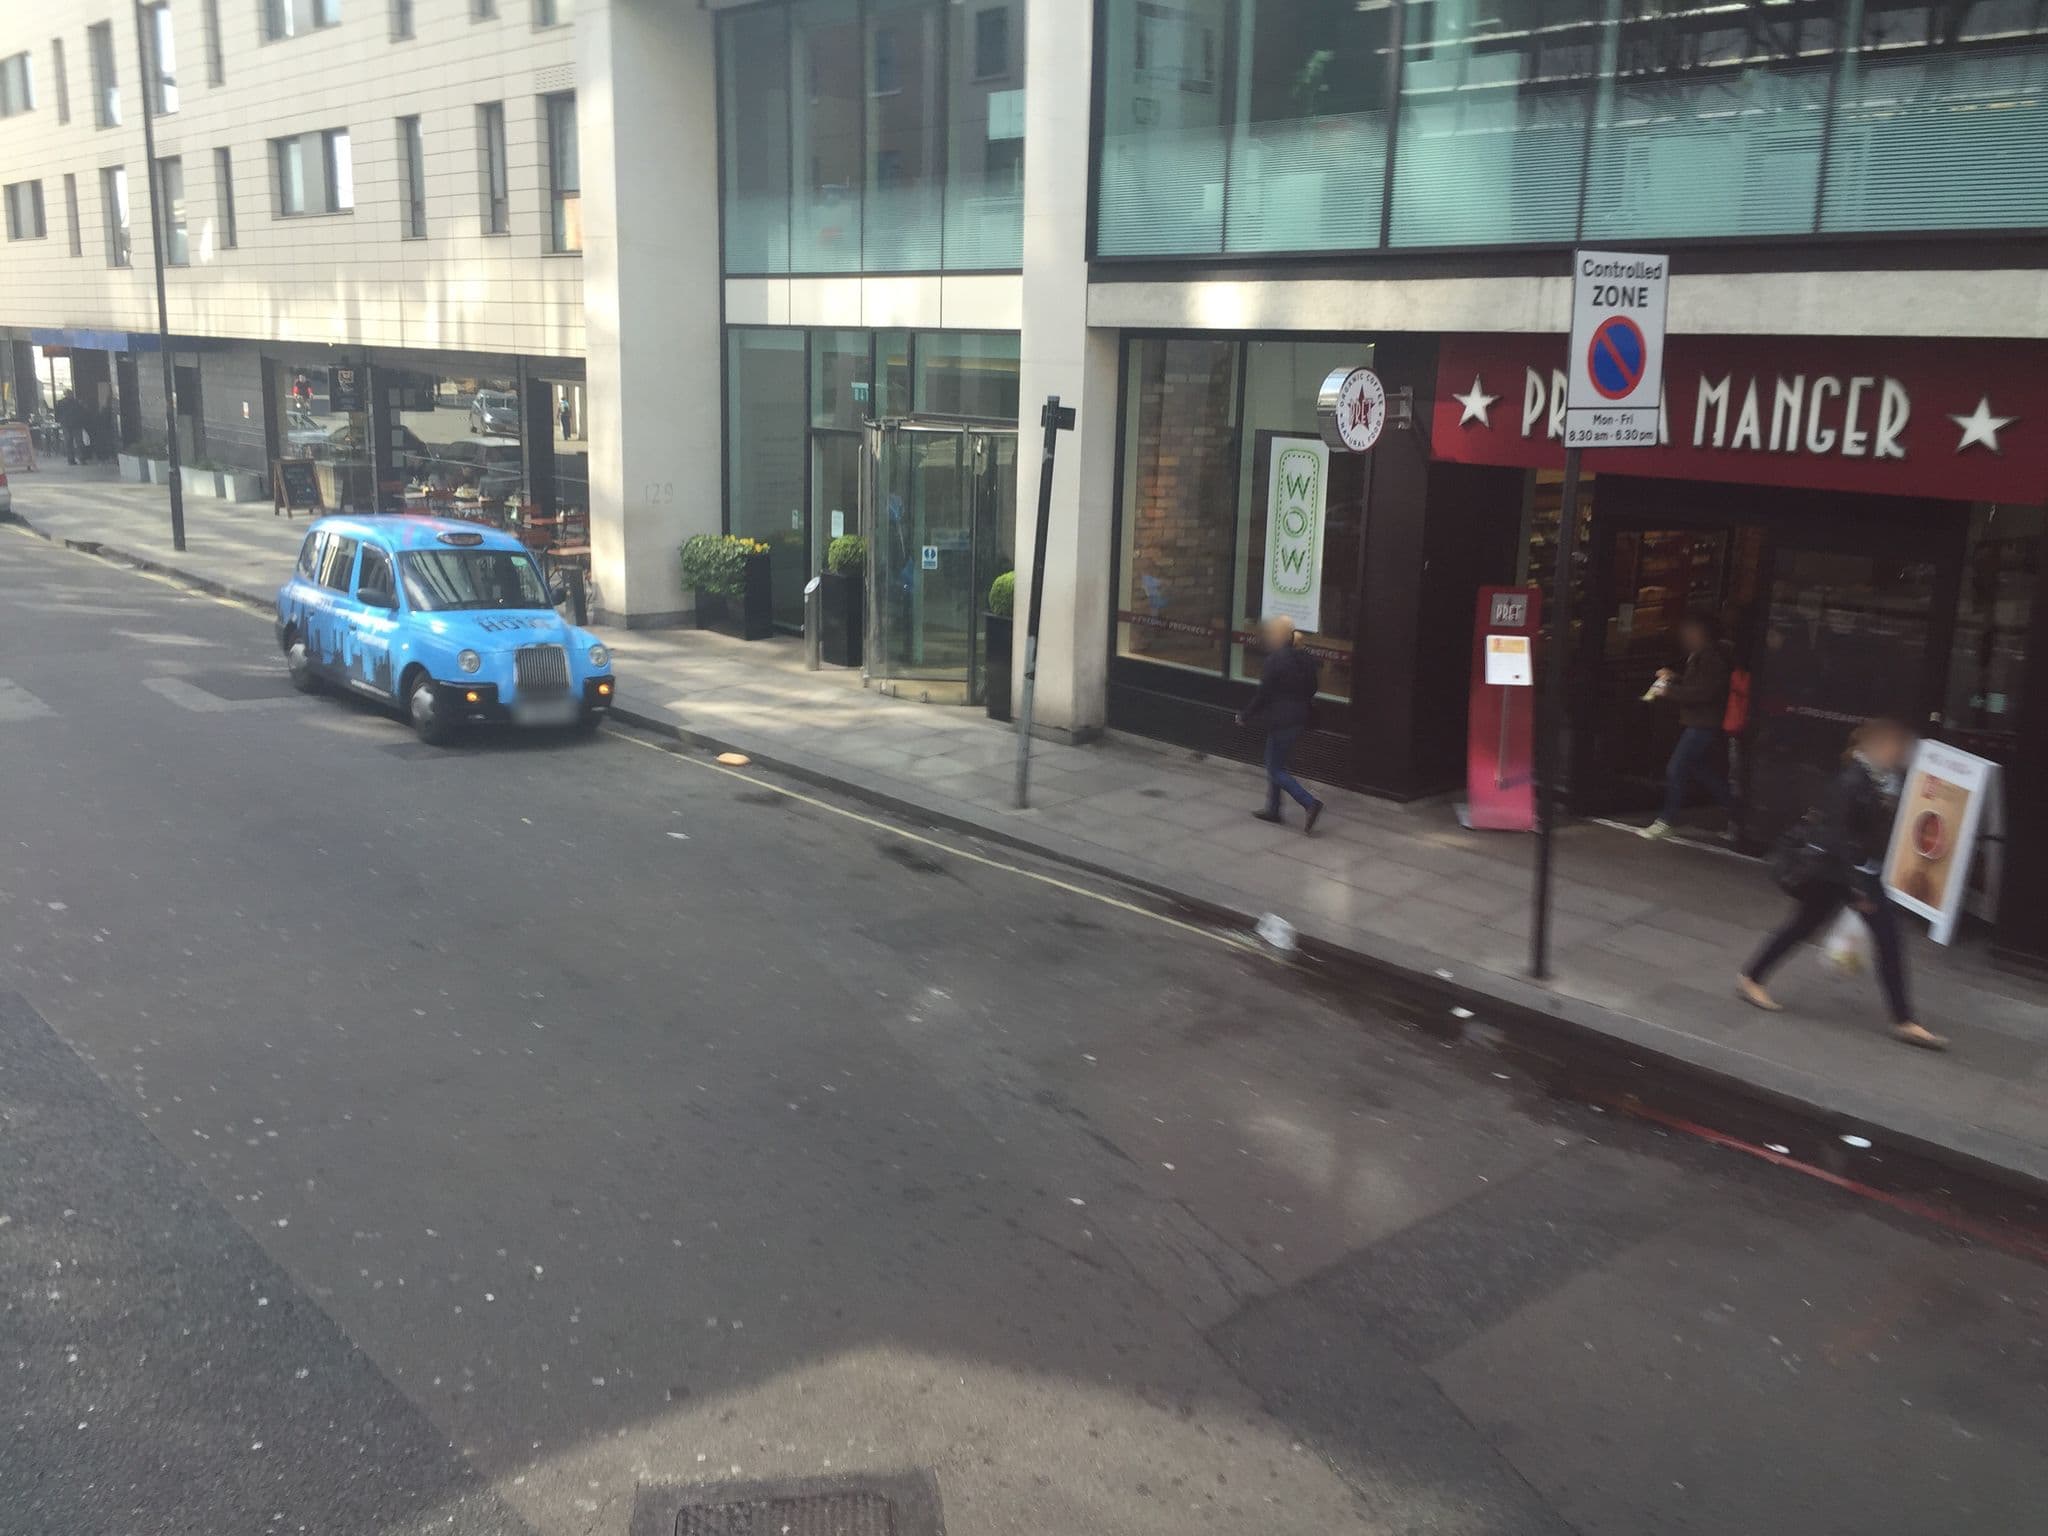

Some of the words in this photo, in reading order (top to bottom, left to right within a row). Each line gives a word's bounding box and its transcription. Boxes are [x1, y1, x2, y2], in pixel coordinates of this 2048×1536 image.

[1583, 259, 1663, 280] Controlled
[1592, 285, 1648, 307] ZONE
[1340, 373, 1364, 406] ORGANIC
[1366, 374, 1383, 405] COFFEE
[1350, 398, 1375, 424] PRET
[1521, 365, 1568, 439] PR
[1694, 373, 1911, 458] MANGER
[1593, 414, 1613, 425] Mon
[1621, 414, 1634, 425] Fri
[1340, 422, 1366, 447] NATURAL
[1368, 420, 1382, 441] FOOD
[1281, 471, 1311, 575] WOW
[1496, 603, 1522, 621] PRET
